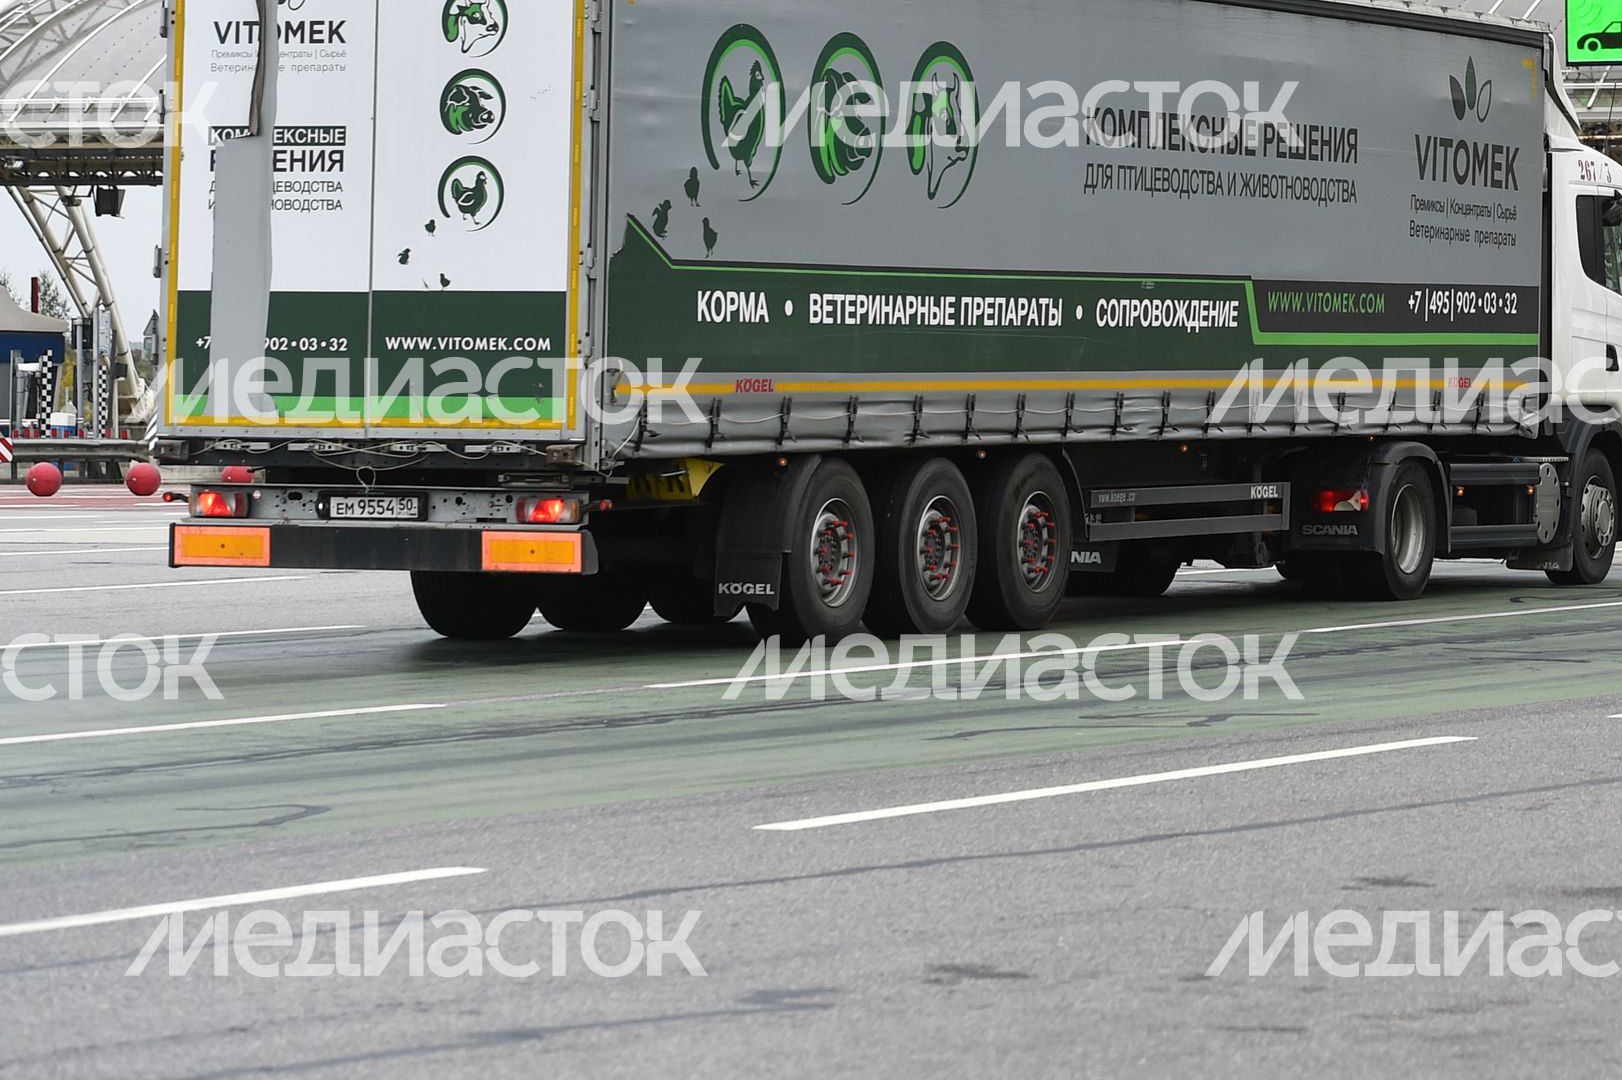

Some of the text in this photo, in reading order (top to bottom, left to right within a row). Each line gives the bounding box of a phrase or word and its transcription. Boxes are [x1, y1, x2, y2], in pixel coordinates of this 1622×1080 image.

[213, 20, 346, 44] VITMEK
[210, 127, 345, 144] КОМЕКСНЫЕ
[1086, 106, 1358, 164] КОМПЛЕКСНЫЕ РЕШЕНИЯ
[1414, 134, 1520, 191] VITOMEK
[1084, 162, 1358, 207] ДЛЯ ПТИЦЕВОДСТВА И ЖИВОТНОВОДСТВА
[1410, 194, 1445, 214] Премиксы
[1450, 198, 1492, 220] Концентраты
[1409, 220, 1516, 250] Ветеринарные препараты
[697, 290, 1239, 333] КОРМА ВЕТЕРИНАРНЫЕ ПРЕПАРАТЫ СОПРОВОЖДЕНИЕ
[1268, 291, 1386, 314] WWW.VITOMEK.COM
[385, 336, 551, 351] WWW.VITOMEK.COM
[735, 377, 774, 393] KÖGEL
[358, 499, 394, 515] 9554
[1302, 524, 1358, 536] SCANIA
[1071, 551, 1102, 564] NIA
[718, 582, 775, 595] KÖGEL
